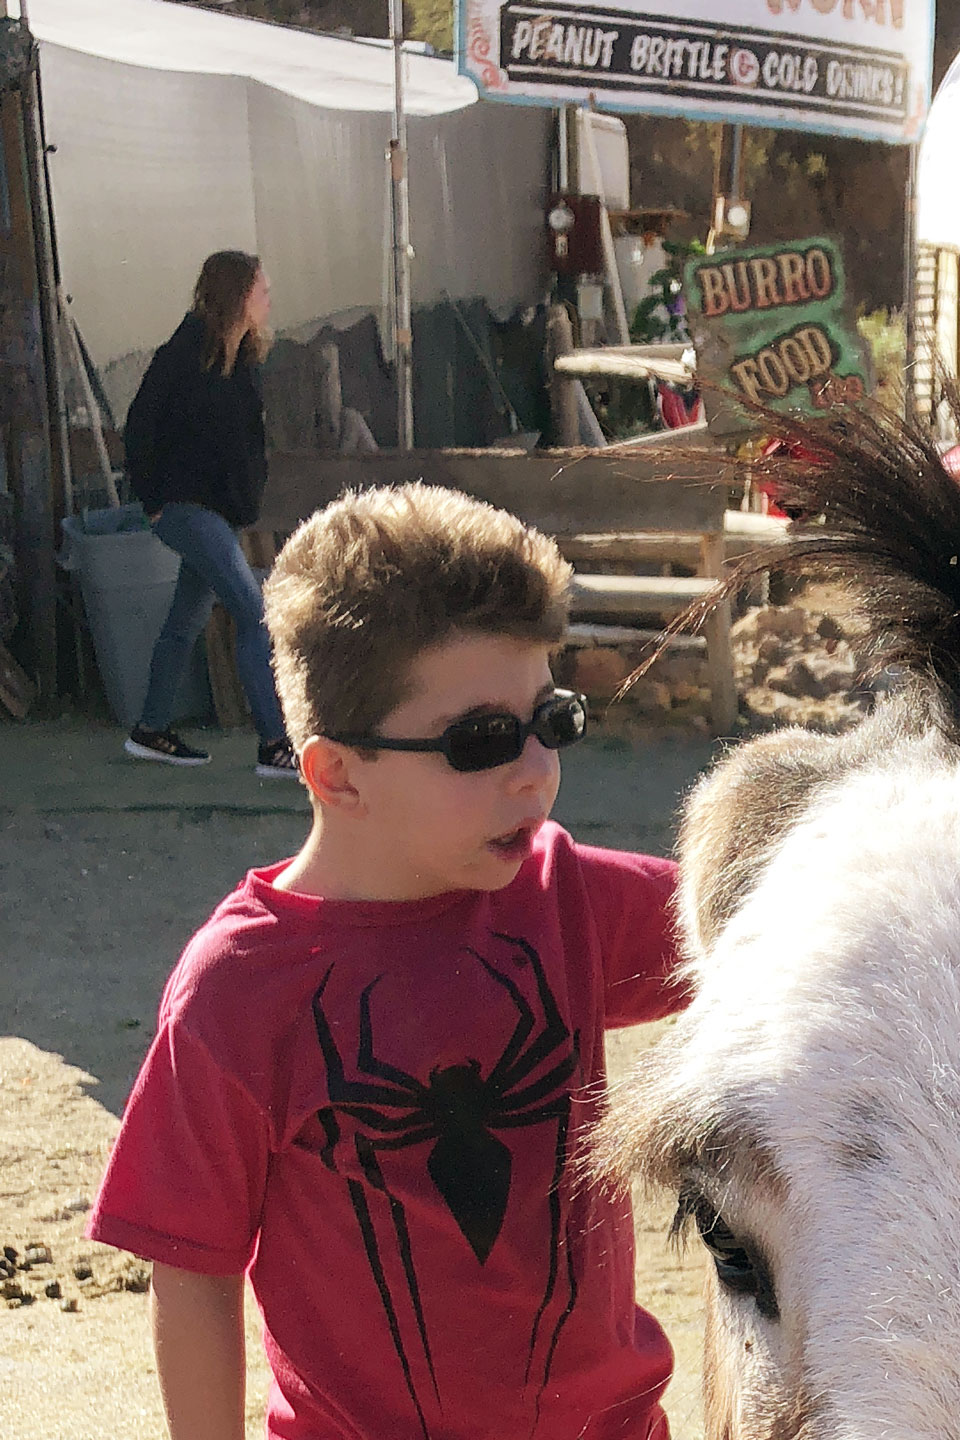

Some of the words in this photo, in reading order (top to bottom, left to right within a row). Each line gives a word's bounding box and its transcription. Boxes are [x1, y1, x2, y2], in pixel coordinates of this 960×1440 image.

[510, 20, 619, 68] PEANUT
[630, 34, 729, 80] BRITTLE
[762, 51, 818, 93] COLD
[698, 249, 832, 317] BURRO
[731, 328, 832, 405] FOOD
